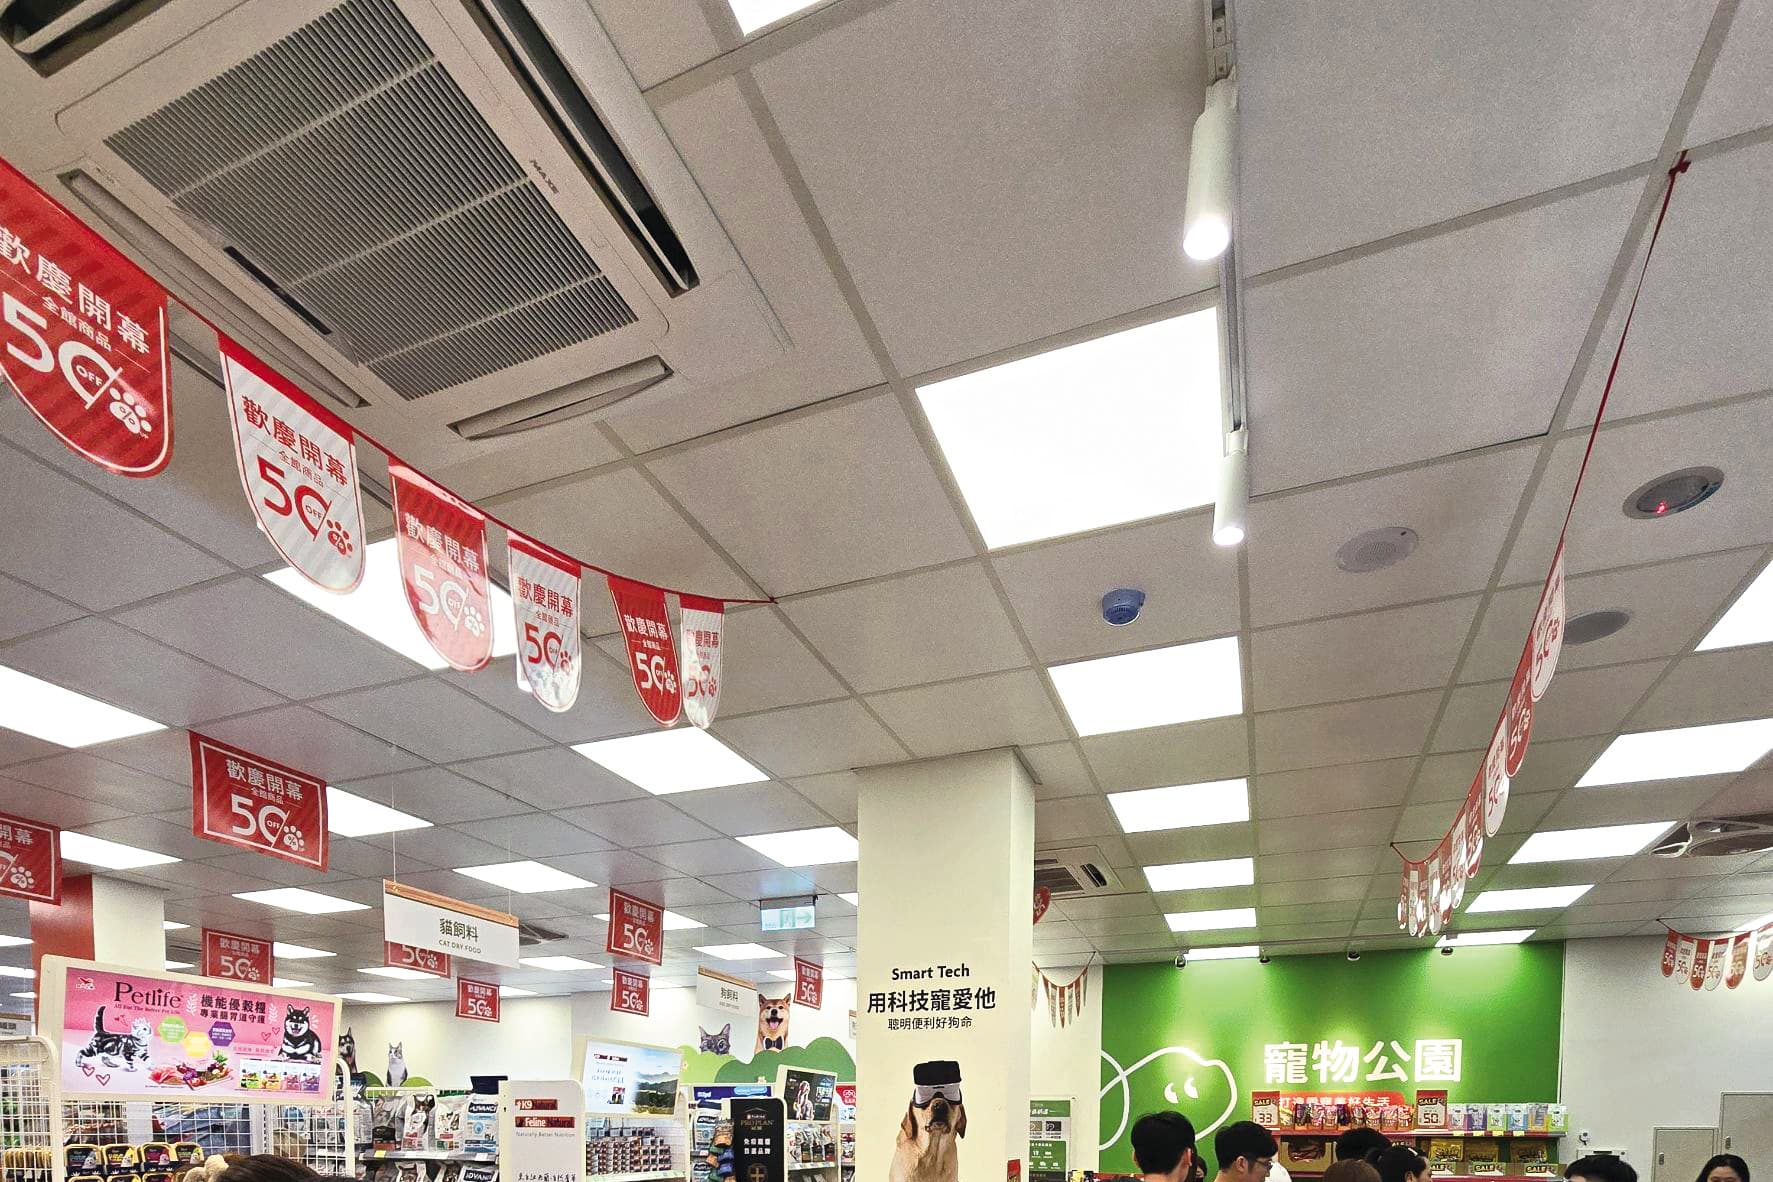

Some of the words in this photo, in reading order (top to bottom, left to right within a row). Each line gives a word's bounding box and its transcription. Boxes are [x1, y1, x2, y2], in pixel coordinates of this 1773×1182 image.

[241, 395, 348, 487] 歡慶開幕
[225, 758, 303, 801] 歡慶開幕
[439, 917, 479, 943] 貓飼料
[891, 966, 933, 981] Smart
[937, 963, 970, 979] Tech
[114, 981, 182, 1009] Petlife
[867, 987, 996, 1014] 用科技寵愛他
[888, 1015, 972, 1031] 聰明便利好狗命
[1263, 1038, 1462, 1084] 寵物公園
[525, 1117, 546, 1127] Feline
[1258, 1112, 1273, 1124] 33
[1475, 1164, 1494, 1172] SALE
